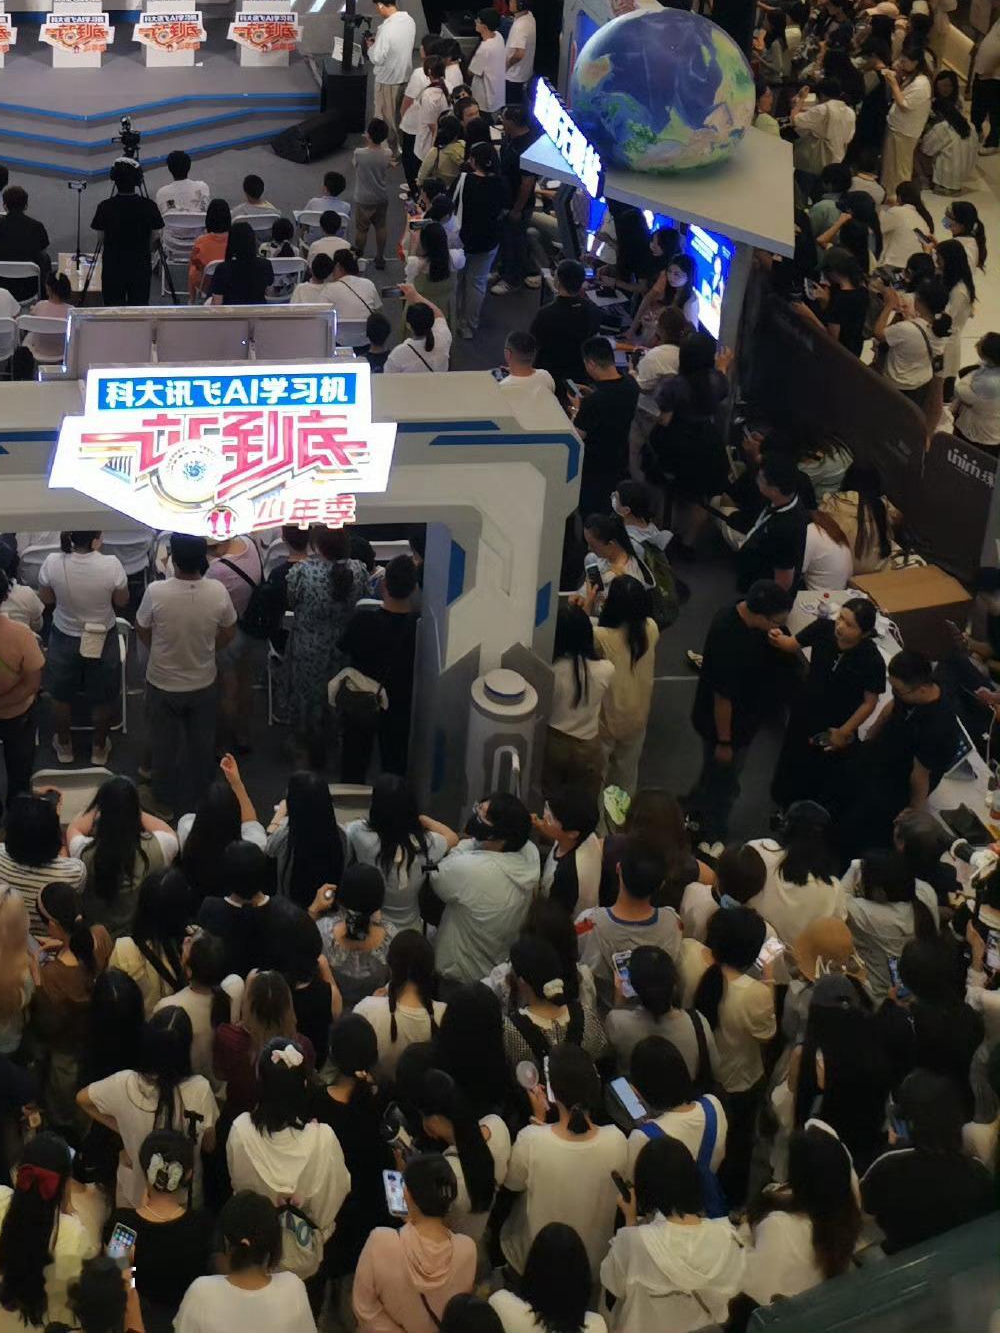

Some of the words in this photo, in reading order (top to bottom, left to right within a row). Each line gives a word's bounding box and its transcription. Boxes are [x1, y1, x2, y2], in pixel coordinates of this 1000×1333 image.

[105, 377, 348, 408] 科大讯飞AI学习机
